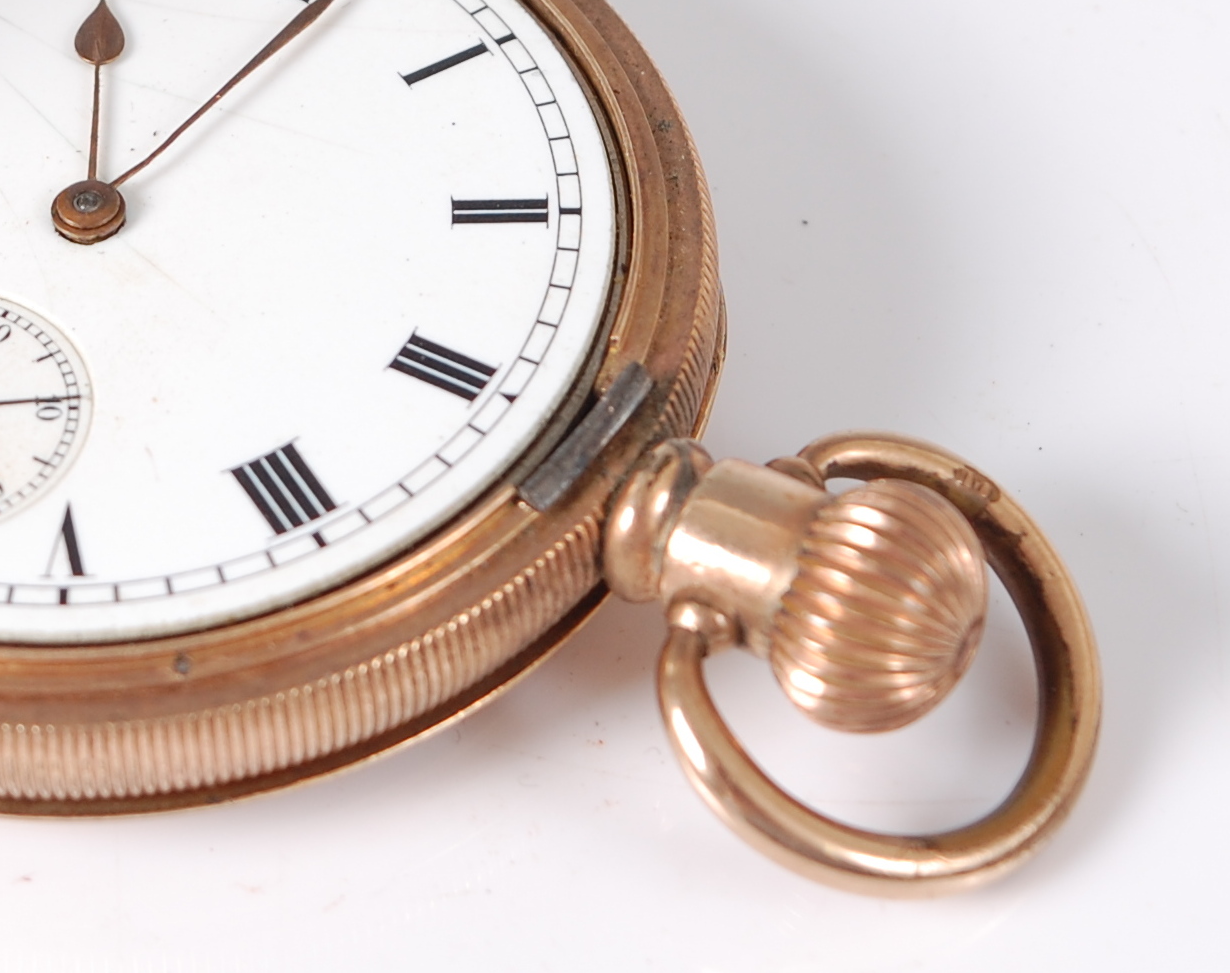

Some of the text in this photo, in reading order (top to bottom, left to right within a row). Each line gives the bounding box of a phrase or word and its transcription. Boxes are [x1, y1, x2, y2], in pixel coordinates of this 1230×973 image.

[397, 37, 494, 88] I
[450, 192, 550, 230] II
[384, 327, 502, 409] III
[34, 394, 64, 423] 10
[220, 436, 350, 542] IIII
[38, 500, 97, 580] V
